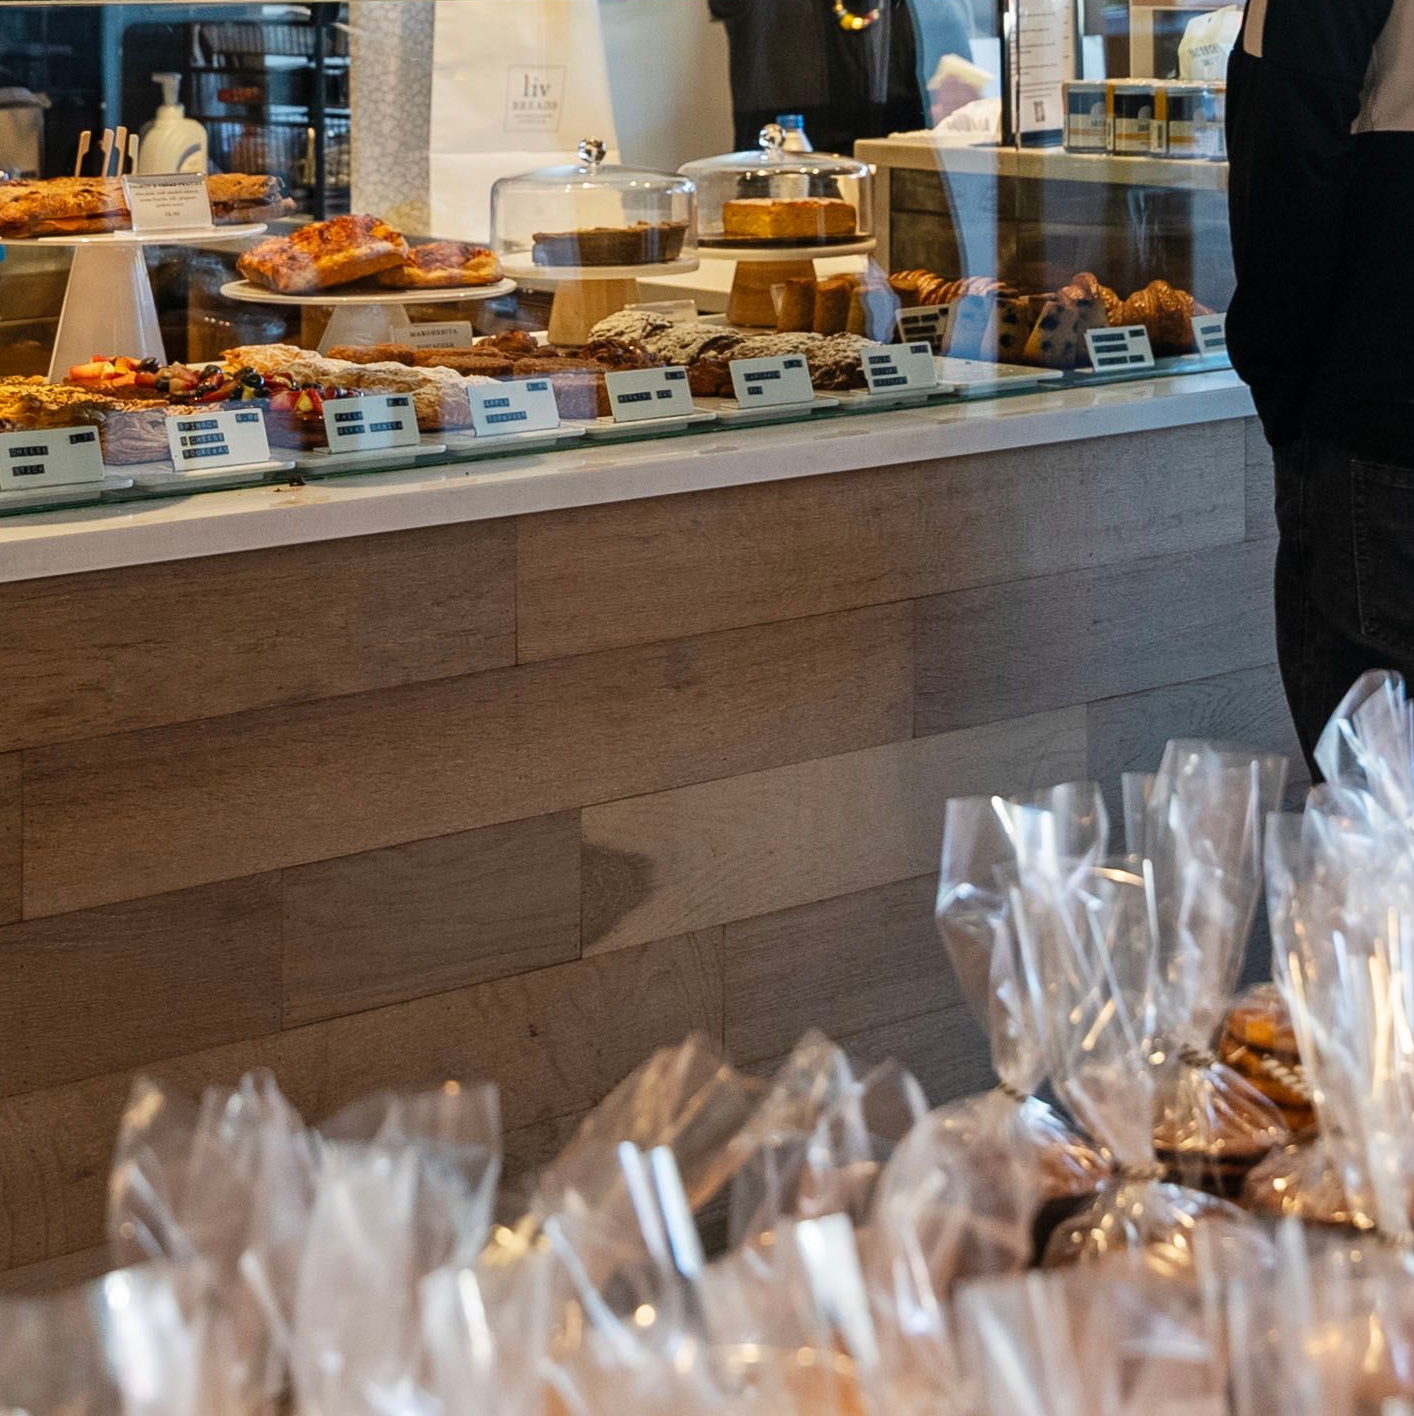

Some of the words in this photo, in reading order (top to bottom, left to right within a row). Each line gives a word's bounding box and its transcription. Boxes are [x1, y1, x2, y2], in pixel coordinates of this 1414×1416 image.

[523, 74, 551, 97] liv
[179, 421, 218, 430] SPINACH
[190, 434, 224, 444] CHEESE
[10, 447, 47, 456] CHEESE
